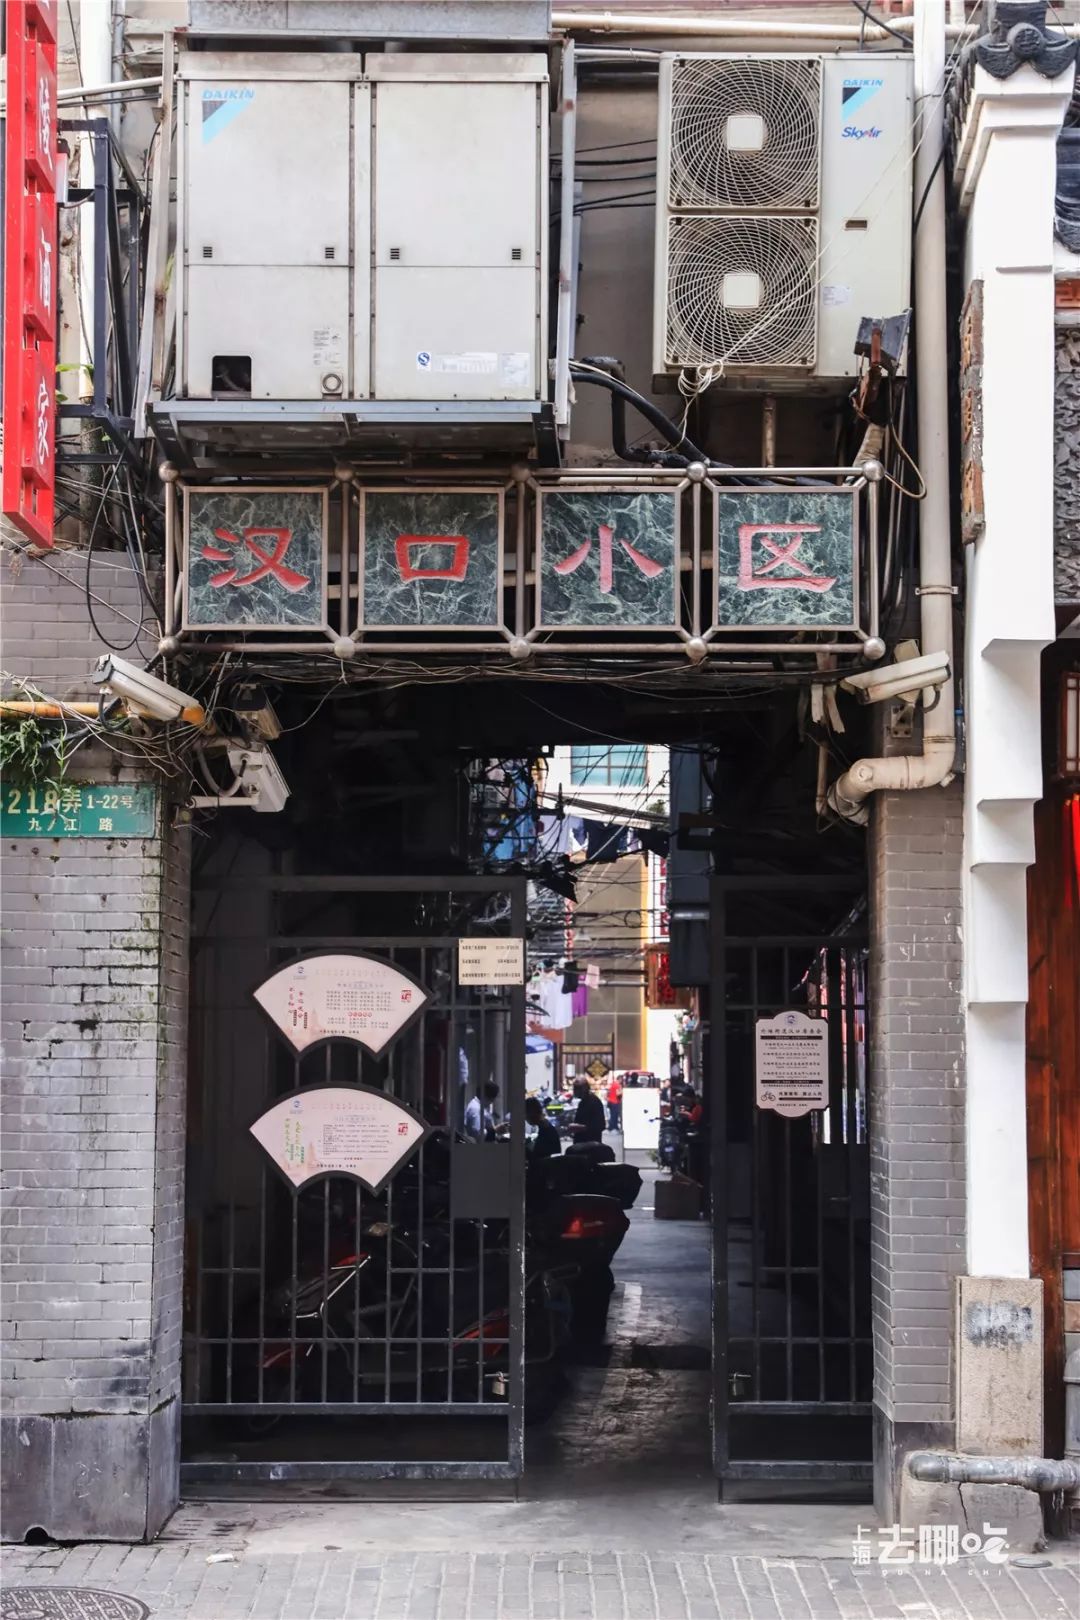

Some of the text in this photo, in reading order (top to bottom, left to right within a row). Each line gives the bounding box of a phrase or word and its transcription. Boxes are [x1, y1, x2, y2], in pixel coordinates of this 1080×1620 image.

[203, 88, 254, 99] DAIKIN
[842, 126, 882, 139] SkyAir
[202, 523, 837, 593] 汉口小区
[8, 787, 134, 814] 218弄 1-22号
